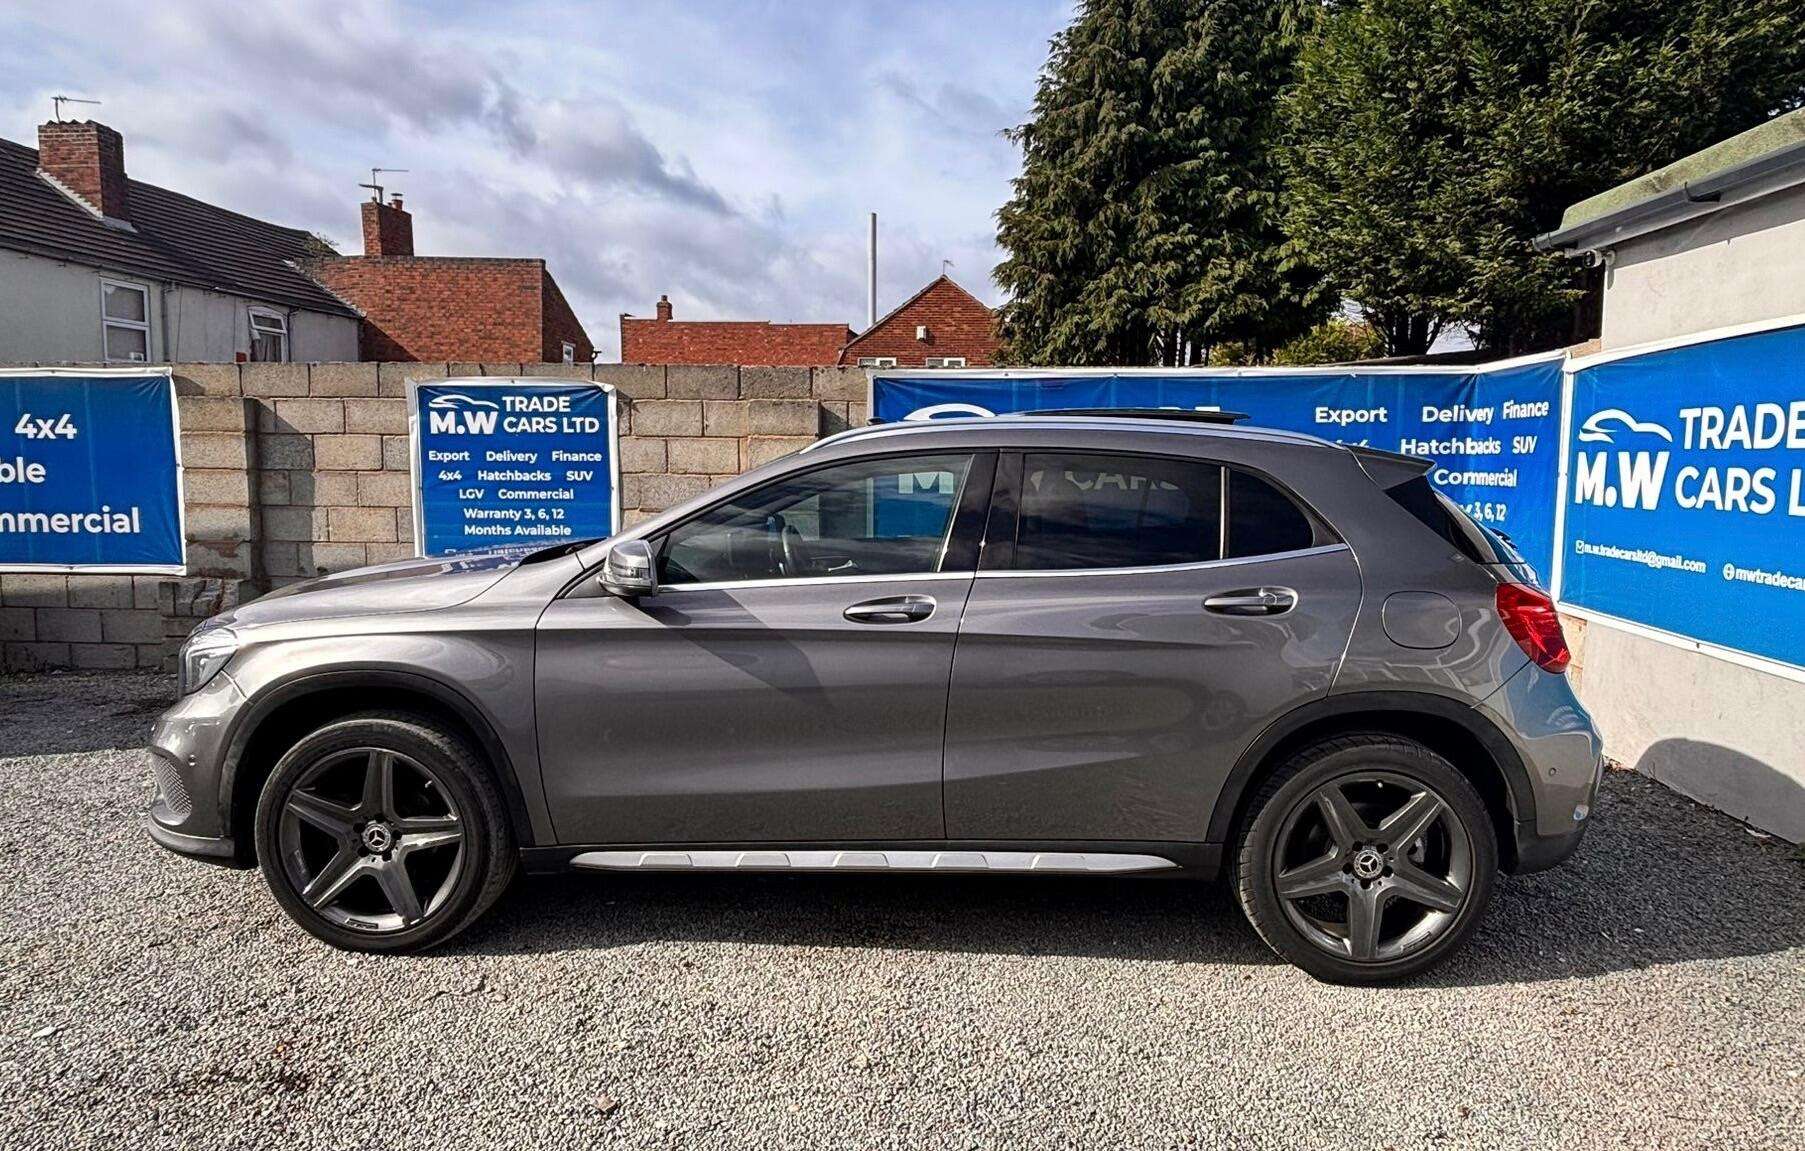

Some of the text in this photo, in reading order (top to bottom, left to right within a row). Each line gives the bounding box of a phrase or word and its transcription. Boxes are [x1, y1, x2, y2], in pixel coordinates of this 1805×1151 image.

[502, 397, 570, 412] TRADE
[1316, 400, 1549, 426] Export Delivery Finance
[15, 414, 77, 439] 4x4
[430, 411, 498, 434] M.W
[504, 417, 599, 432] CARS LTD
[1680, 401, 1805, 449] TRADE
[1401, 436, 1537, 455] Hatchbacks SUV
[429, 450, 602, 463] Export Delivery Finance
[439, 471, 593, 480] 4x4 Hatchbacks SUV
[1434, 468, 1517, 487] Commercial
[1575, 452, 1669, 510] M.W
[460, 489, 573, 499] LGV Commercial
[1676, 467, 1776, 514] CARS
[464, 509, 564, 520] Warranty 3, 6, 12
[1474, 502, 1483, 520] 3,
[1485, 503, 1494, 521] 6,
[1496, 504, 1506, 520] 12
[465, 525, 571, 535] Months Available
